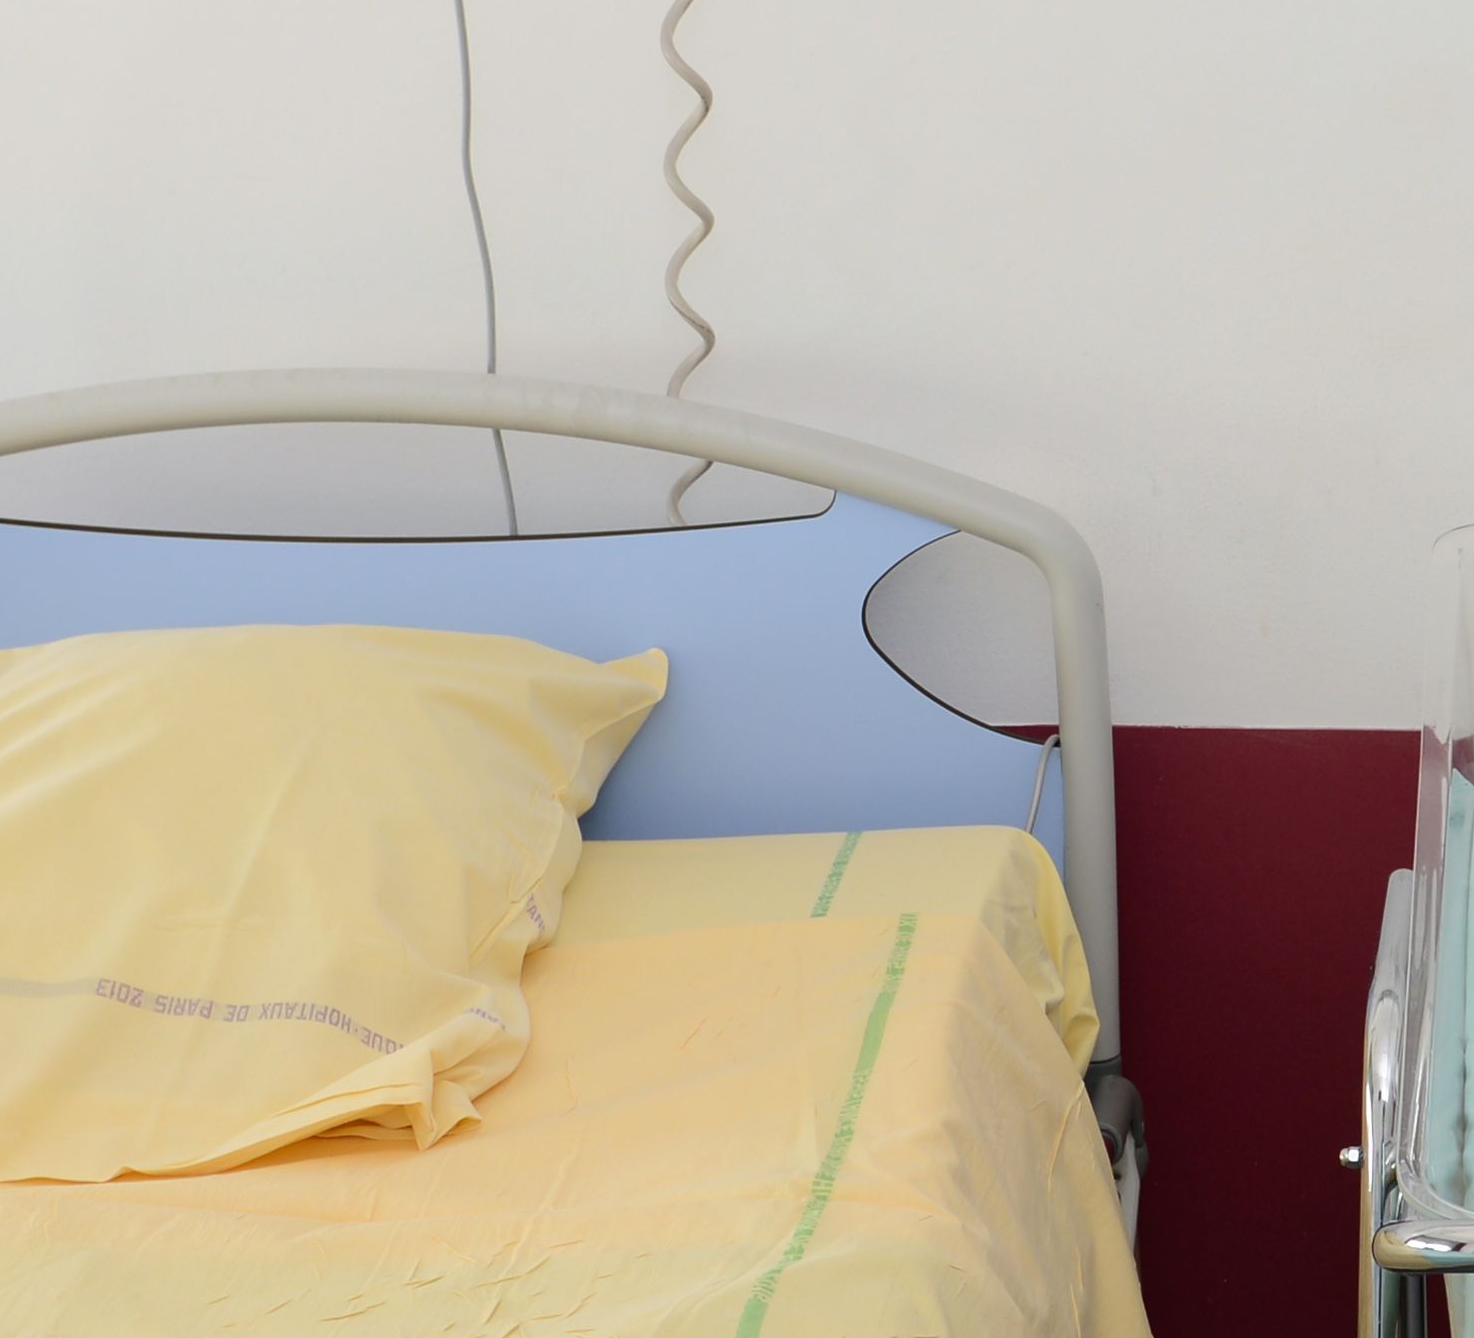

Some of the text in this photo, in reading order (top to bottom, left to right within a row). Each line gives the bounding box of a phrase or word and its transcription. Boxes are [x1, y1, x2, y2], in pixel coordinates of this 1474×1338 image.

[96, 978, 144, 1007] 2013
[154, 994, 213, 1019] PARIS
[225, 1004, 251, 1022] DE
